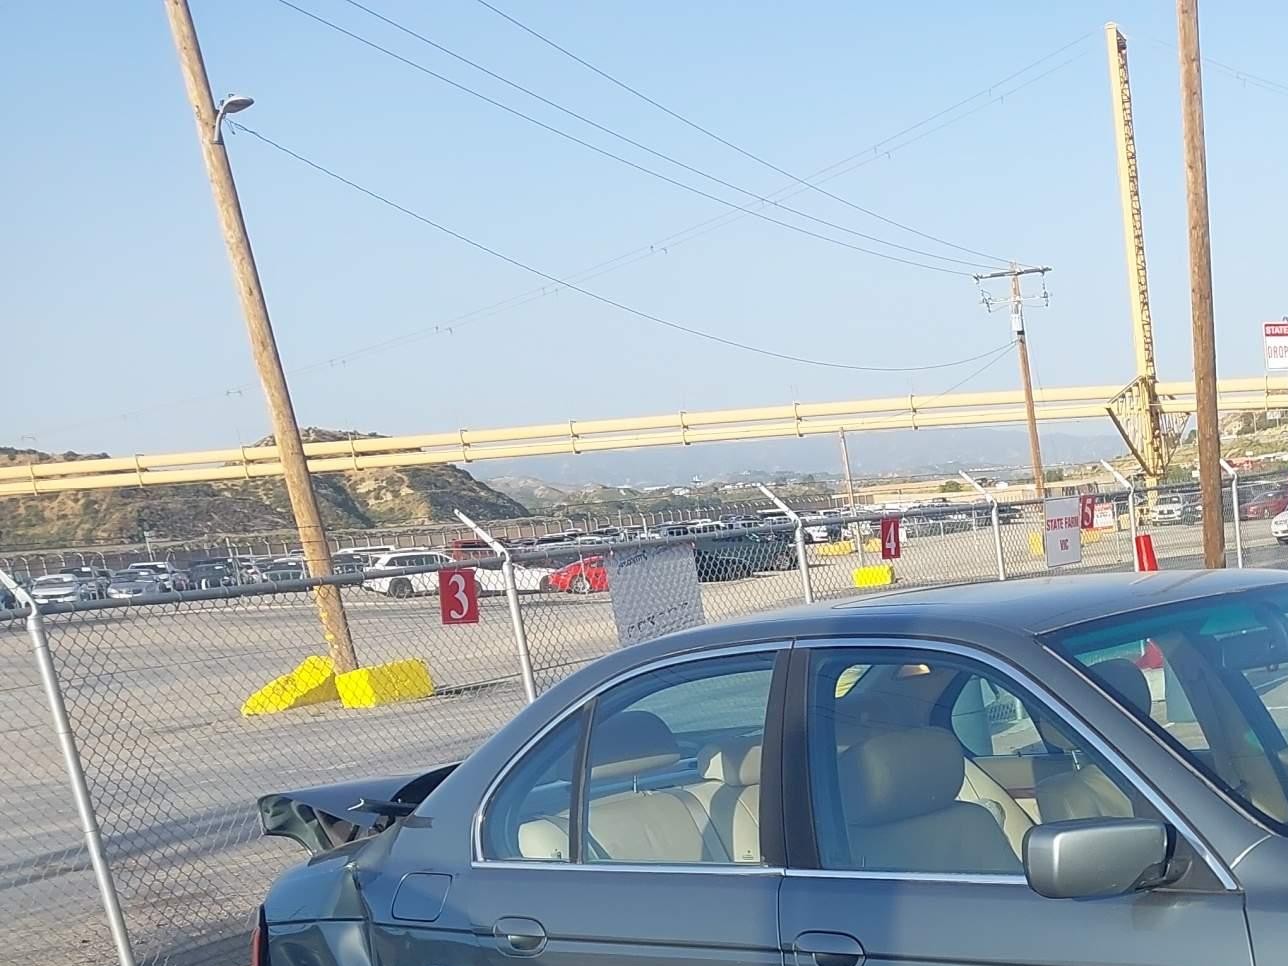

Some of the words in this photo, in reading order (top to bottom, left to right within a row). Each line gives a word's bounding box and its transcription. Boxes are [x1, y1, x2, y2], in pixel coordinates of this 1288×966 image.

[1265, 325, 1288, 334] STATE
[1267, 346, 1288, 359] DROP
[1083, 498, 1092, 526] 5
[1046, 518, 1064, 531] STATE
[885, 521, 897, 556] 4
[448, 574, 469, 619] 3
